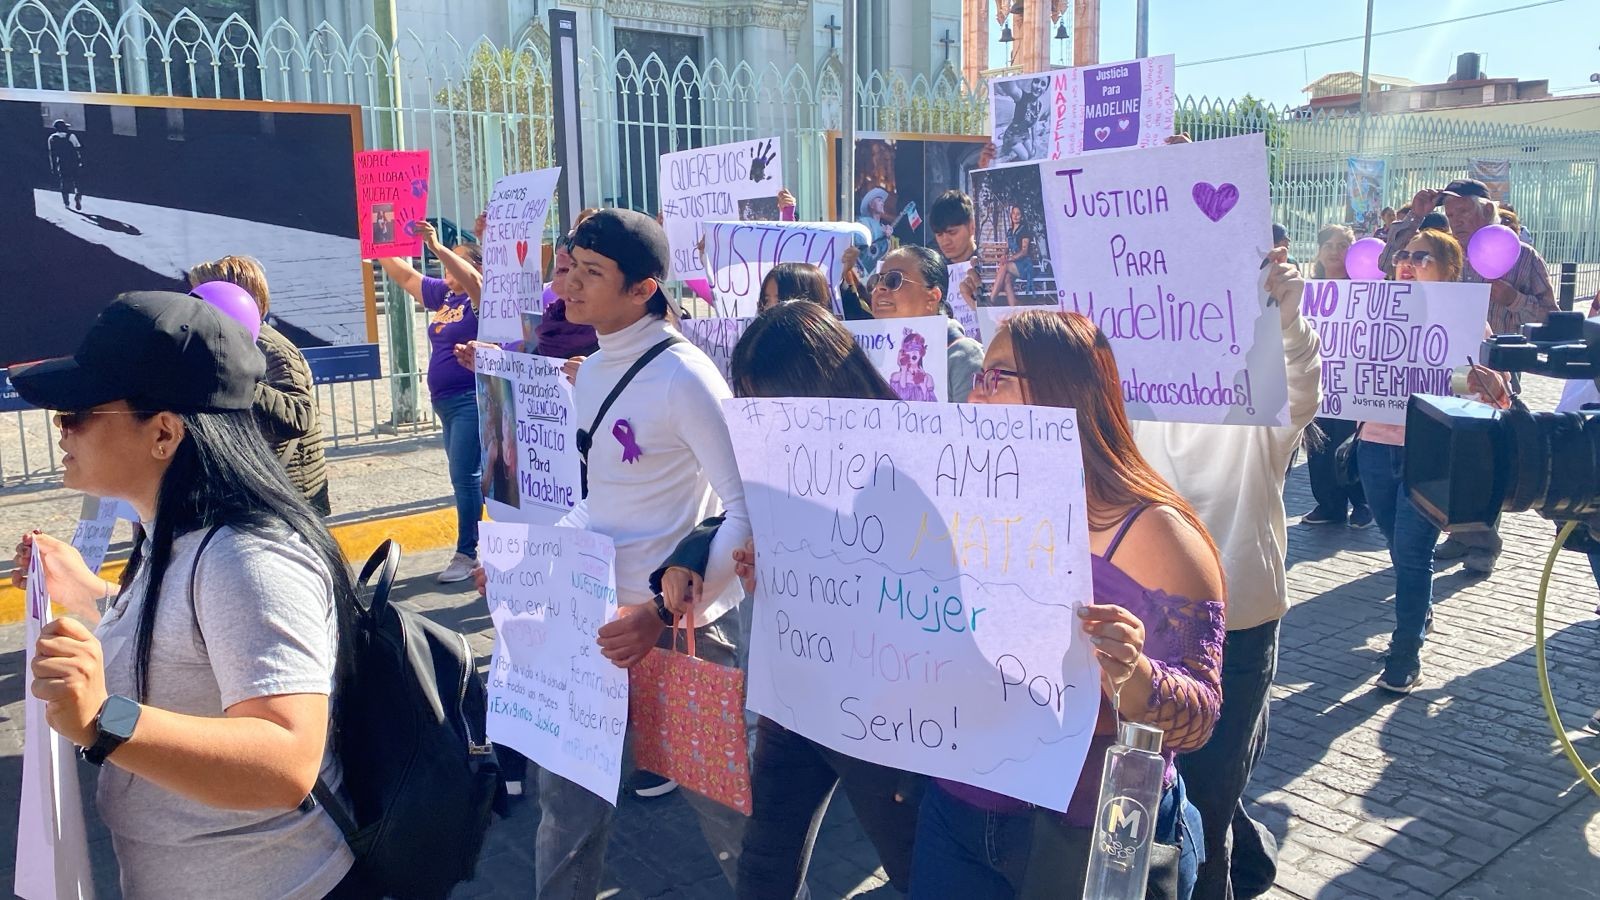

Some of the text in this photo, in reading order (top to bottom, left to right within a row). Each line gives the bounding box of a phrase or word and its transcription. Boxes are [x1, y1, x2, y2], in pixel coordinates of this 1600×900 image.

[1096, 66, 1129, 81] Justicia
[1102, 86, 1121, 97] Para
[1085, 97, 1139, 119] MADELINE
[671, 151, 746, 191] QUEREMOS
[363, 187, 399, 202] MUERTA
[490, 181, 527, 202] EXIGIMOS
[488, 198, 547, 222] QUE EL CASO
[664, 192, 733, 218] #JUSTICIA
[487, 221, 533, 243] SE REVISE
[486, 246, 508, 266] COMO
[483, 300, 497, 319] DE
[1302, 281, 1411, 322] NO FUE
[896, 402, 942, 434] Para
[957, 403, 1074, 442] Madeline
[527, 448, 550, 473] Para
[936, 444, 1019, 499] AMA
[521, 470, 574, 507] Madeline
[507, 538, 520, 553] es
[523, 536, 562, 557] normal
[520, 571, 544, 586] con
[527, 600, 544, 615] en
[879, 576, 987, 632] Mujer
[776, 610, 834, 663] Para
[996, 654, 1075, 712] Por
[492, 675, 504, 688] de
[840, 696, 958, 750] Serlo!
